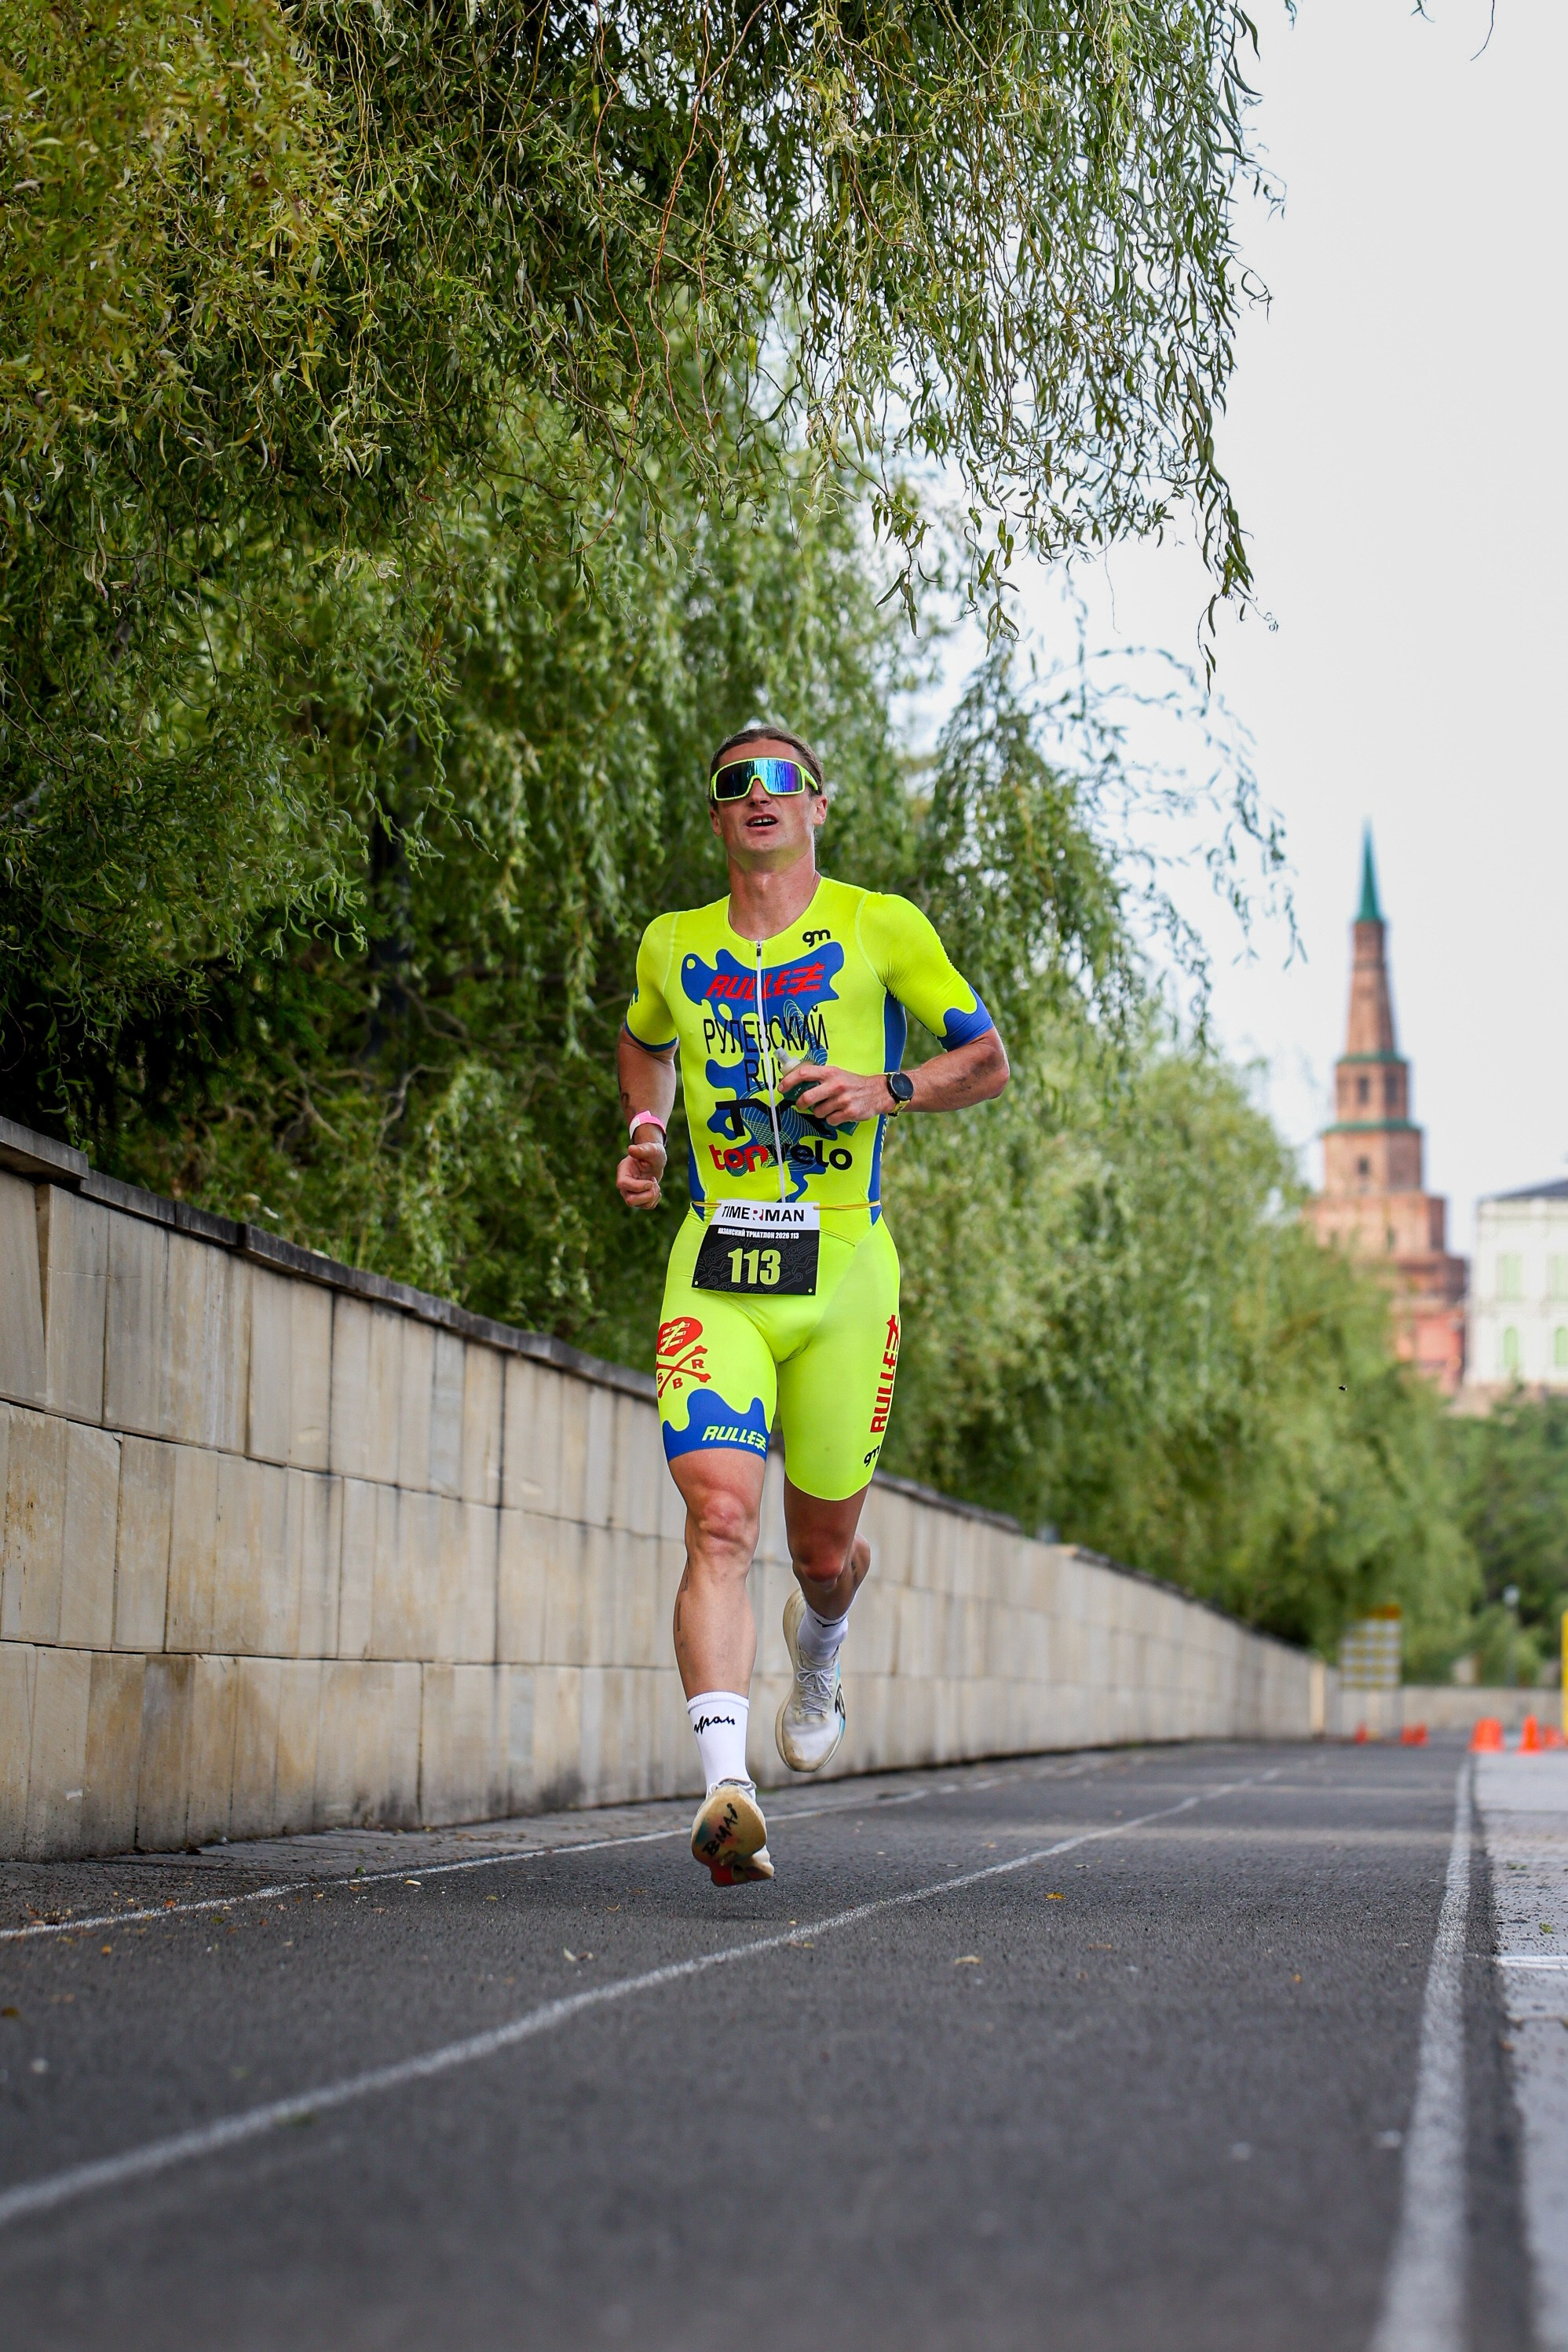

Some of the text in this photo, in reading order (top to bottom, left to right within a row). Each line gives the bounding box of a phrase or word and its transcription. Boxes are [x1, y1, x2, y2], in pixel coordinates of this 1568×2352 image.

[802, 929, 831, 948] gm
[703, 1005, 829, 1054] РУЛЕВСКИЙ
[727, 1248, 781, 1286] 113
